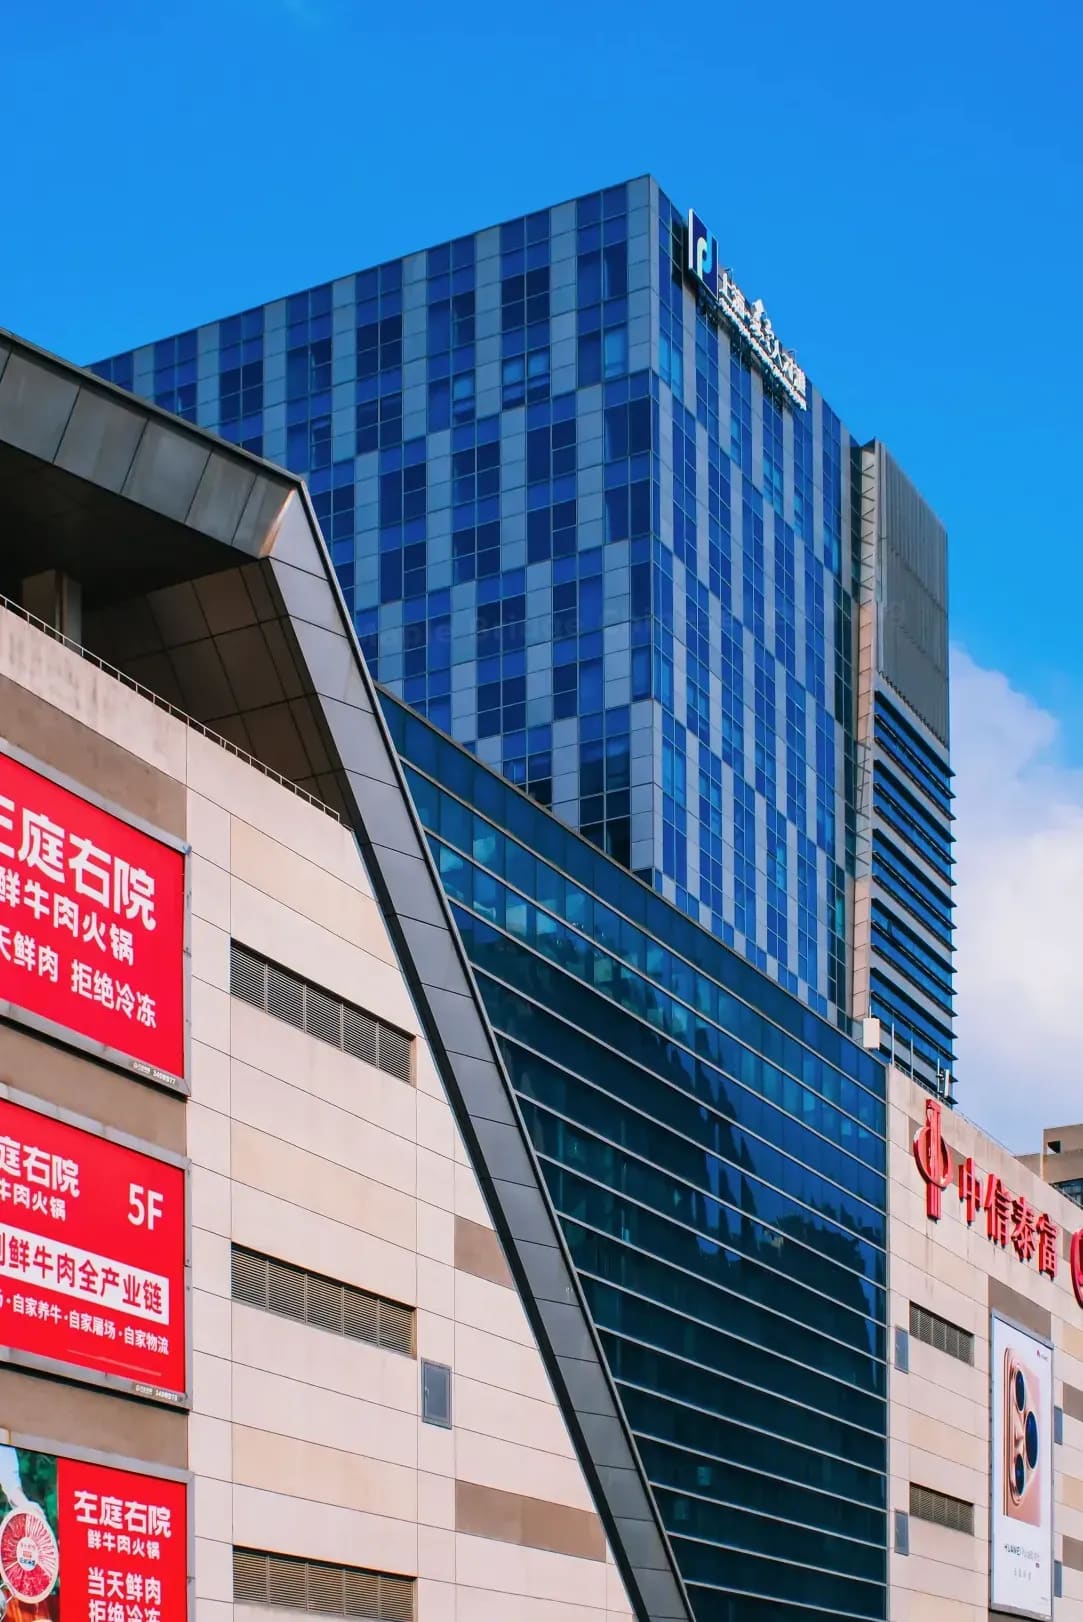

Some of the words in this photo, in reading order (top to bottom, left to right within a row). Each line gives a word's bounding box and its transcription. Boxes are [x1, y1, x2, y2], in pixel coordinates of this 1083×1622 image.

[71, 959, 157, 1028] 拒绝冷冻
[128, 1183, 163, 1231] 5F
[0, 1232, 163, 1315] 鲜牛肉全产业链
[74, 1490, 172, 1538] 左庭石院
[87, 1528, 160, 1560] 鲜牛肉火锅
[88, 1566, 161, 1606] 当天鲜肉
